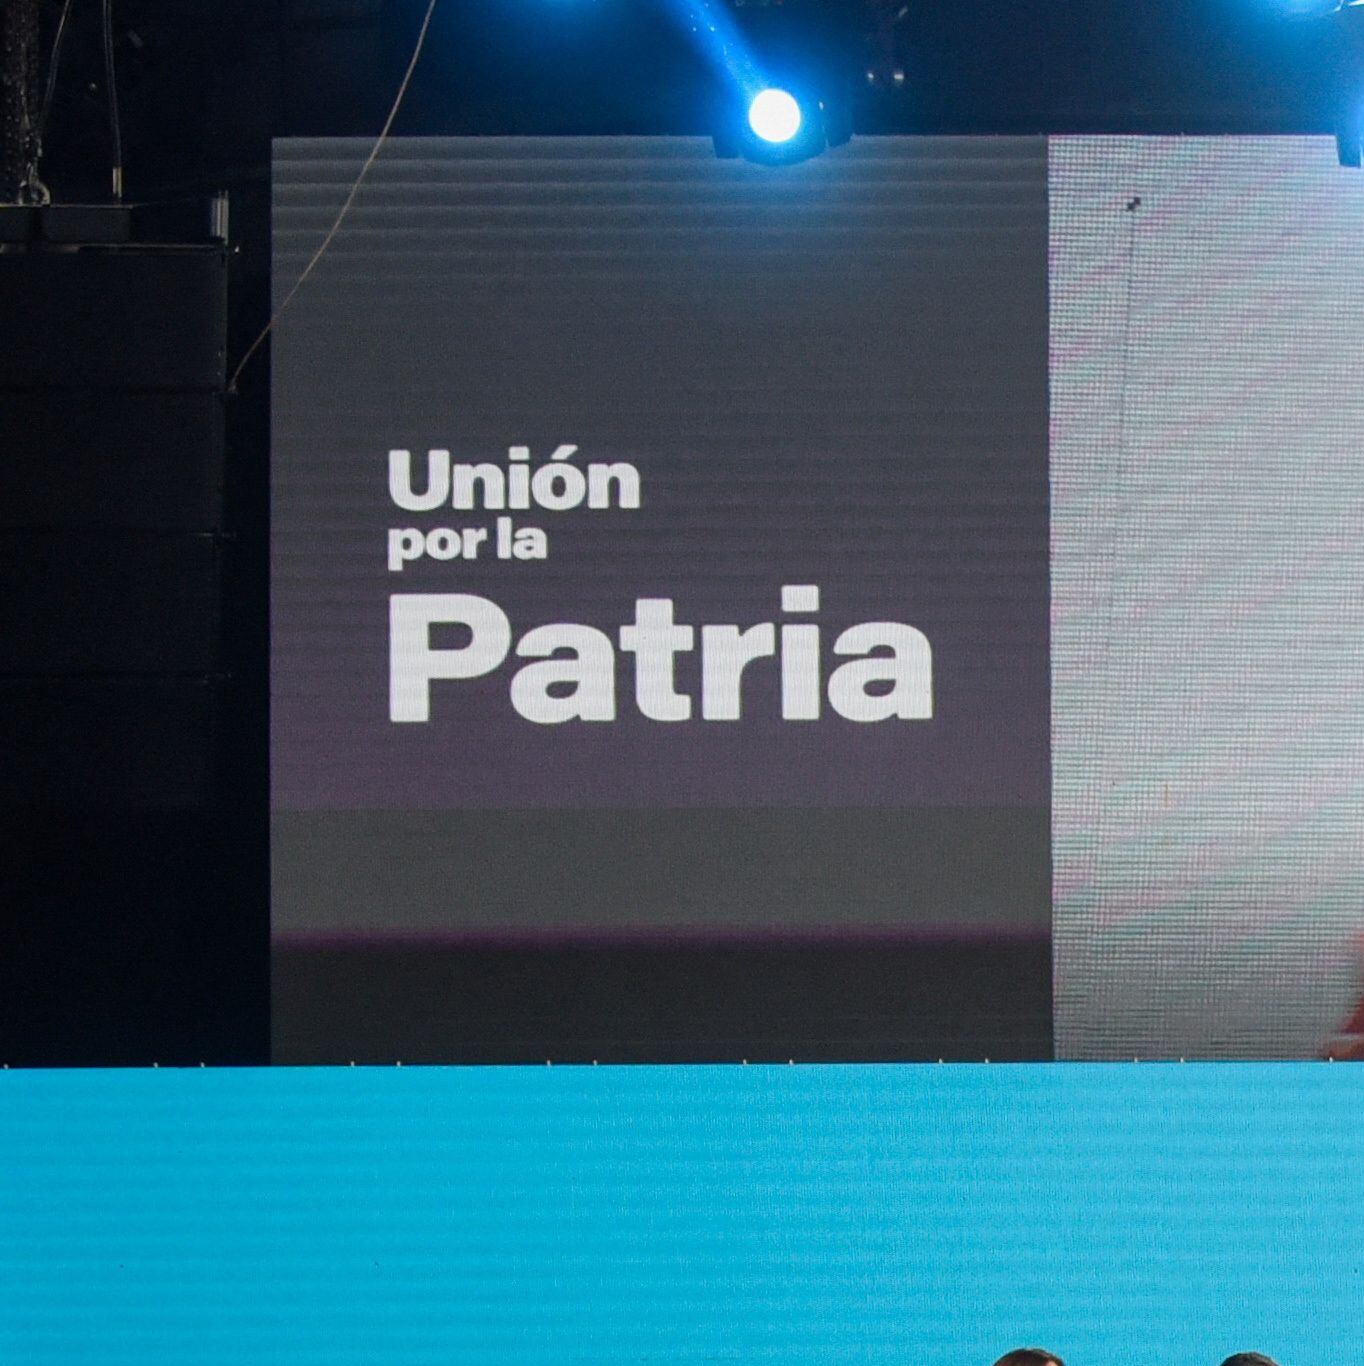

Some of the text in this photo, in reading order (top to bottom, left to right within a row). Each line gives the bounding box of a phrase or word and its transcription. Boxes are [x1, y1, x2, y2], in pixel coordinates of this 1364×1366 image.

[388, 444, 641, 512] Unión
[387, 516, 548, 572] por la
[389, 584, 934, 724] Patria
